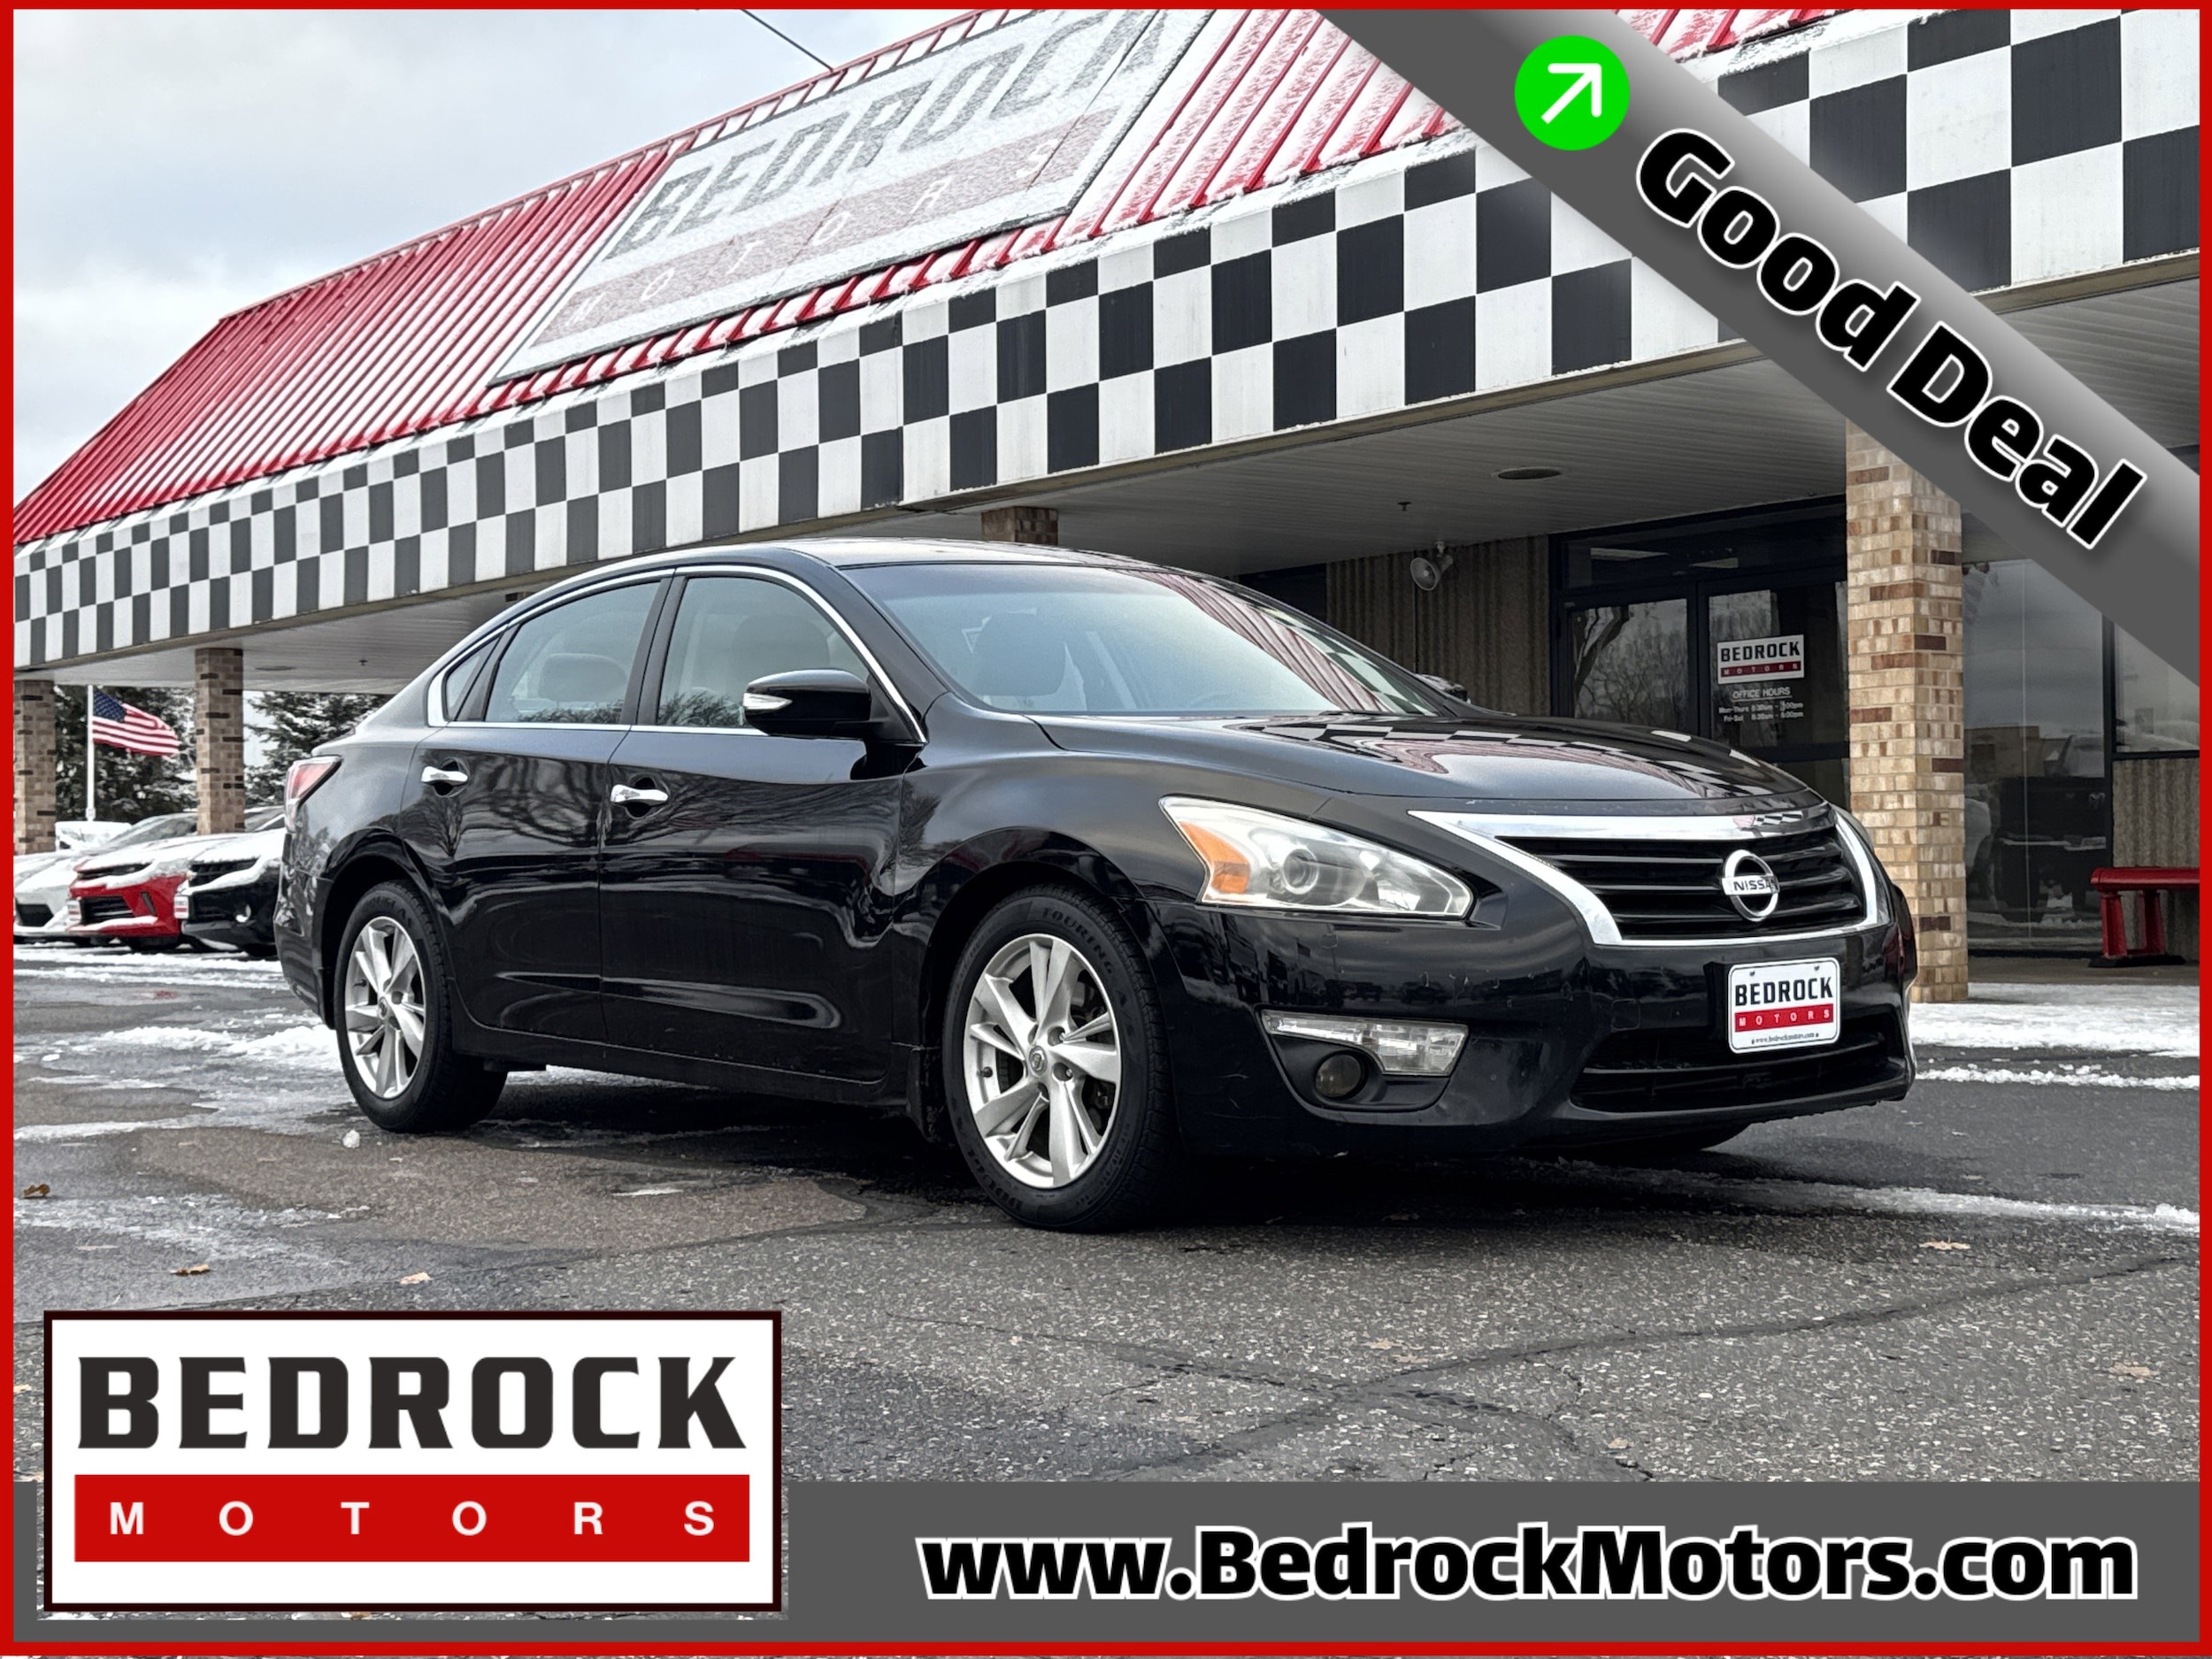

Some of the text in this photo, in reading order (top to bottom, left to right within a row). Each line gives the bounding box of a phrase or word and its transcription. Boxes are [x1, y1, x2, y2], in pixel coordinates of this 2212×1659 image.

[1720, 641, 1801, 662] BEDROCK
[1724, 663, 1799, 676] MOTORS
[1732, 686, 1791, 699] OFFICE HOURS
[1042, 908, 1112, 973] TOURING
[1735, 977, 1833, 1007] BEDROCK
[1739, 1009, 1831, 1027] MOTORS
